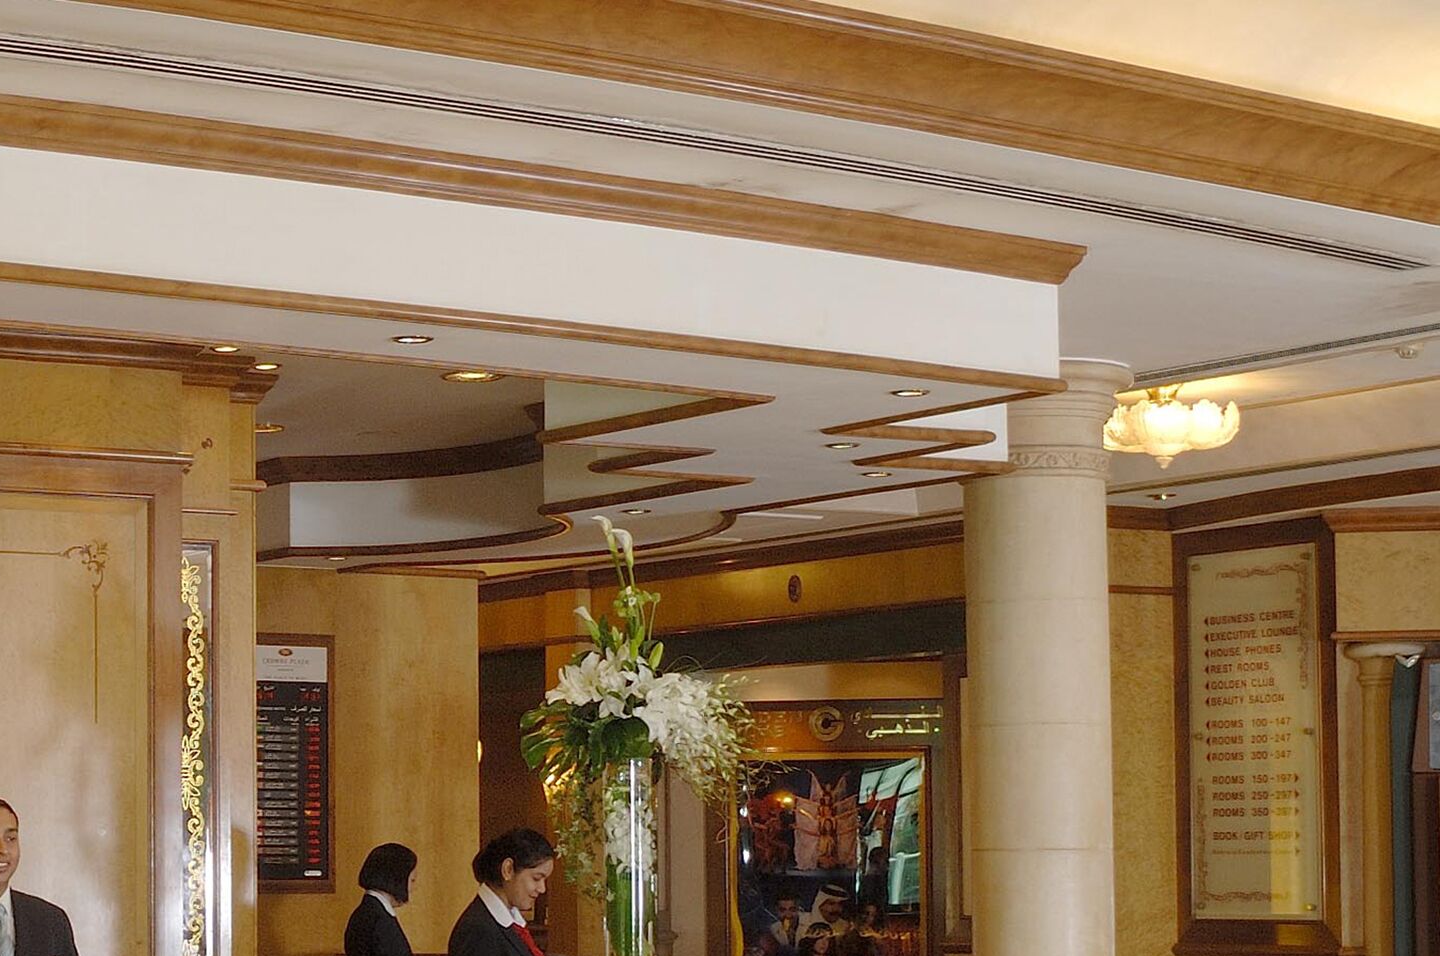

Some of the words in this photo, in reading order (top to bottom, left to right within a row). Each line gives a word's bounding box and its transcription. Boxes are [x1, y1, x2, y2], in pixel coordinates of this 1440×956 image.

[1209, 613, 1255, 625] BUSINESS
[1259, 609, 1295, 621] CENTRE
[1210, 629, 1258, 642] EXECUTIVE
[1261, 626, 1298, 638] LOUNGE
[1210, 646, 1241, 657] HOUSE
[1245, 644, 1282, 655] PHONES
[1210, 663, 1233, 674] REST
[1237, 661, 1270, 672] ROOMS
[1211, 679, 1247, 690] GOLDEN
[1250, 677, 1275, 688] CLUB
[1210, 695, 1244, 706] BEAUTY
[1248, 693, 1285, 704] SALOON
[1211, 720, 1244, 729] ROOMS
[1211, 735, 1244, 745] ROOMS
[1212, 752, 1244, 761] ROOMS
[1212, 775, 1245, 785] ROOMS
[1212, 791, 1245, 801] ROOMS
[1212, 807, 1245, 817] ROOMS
